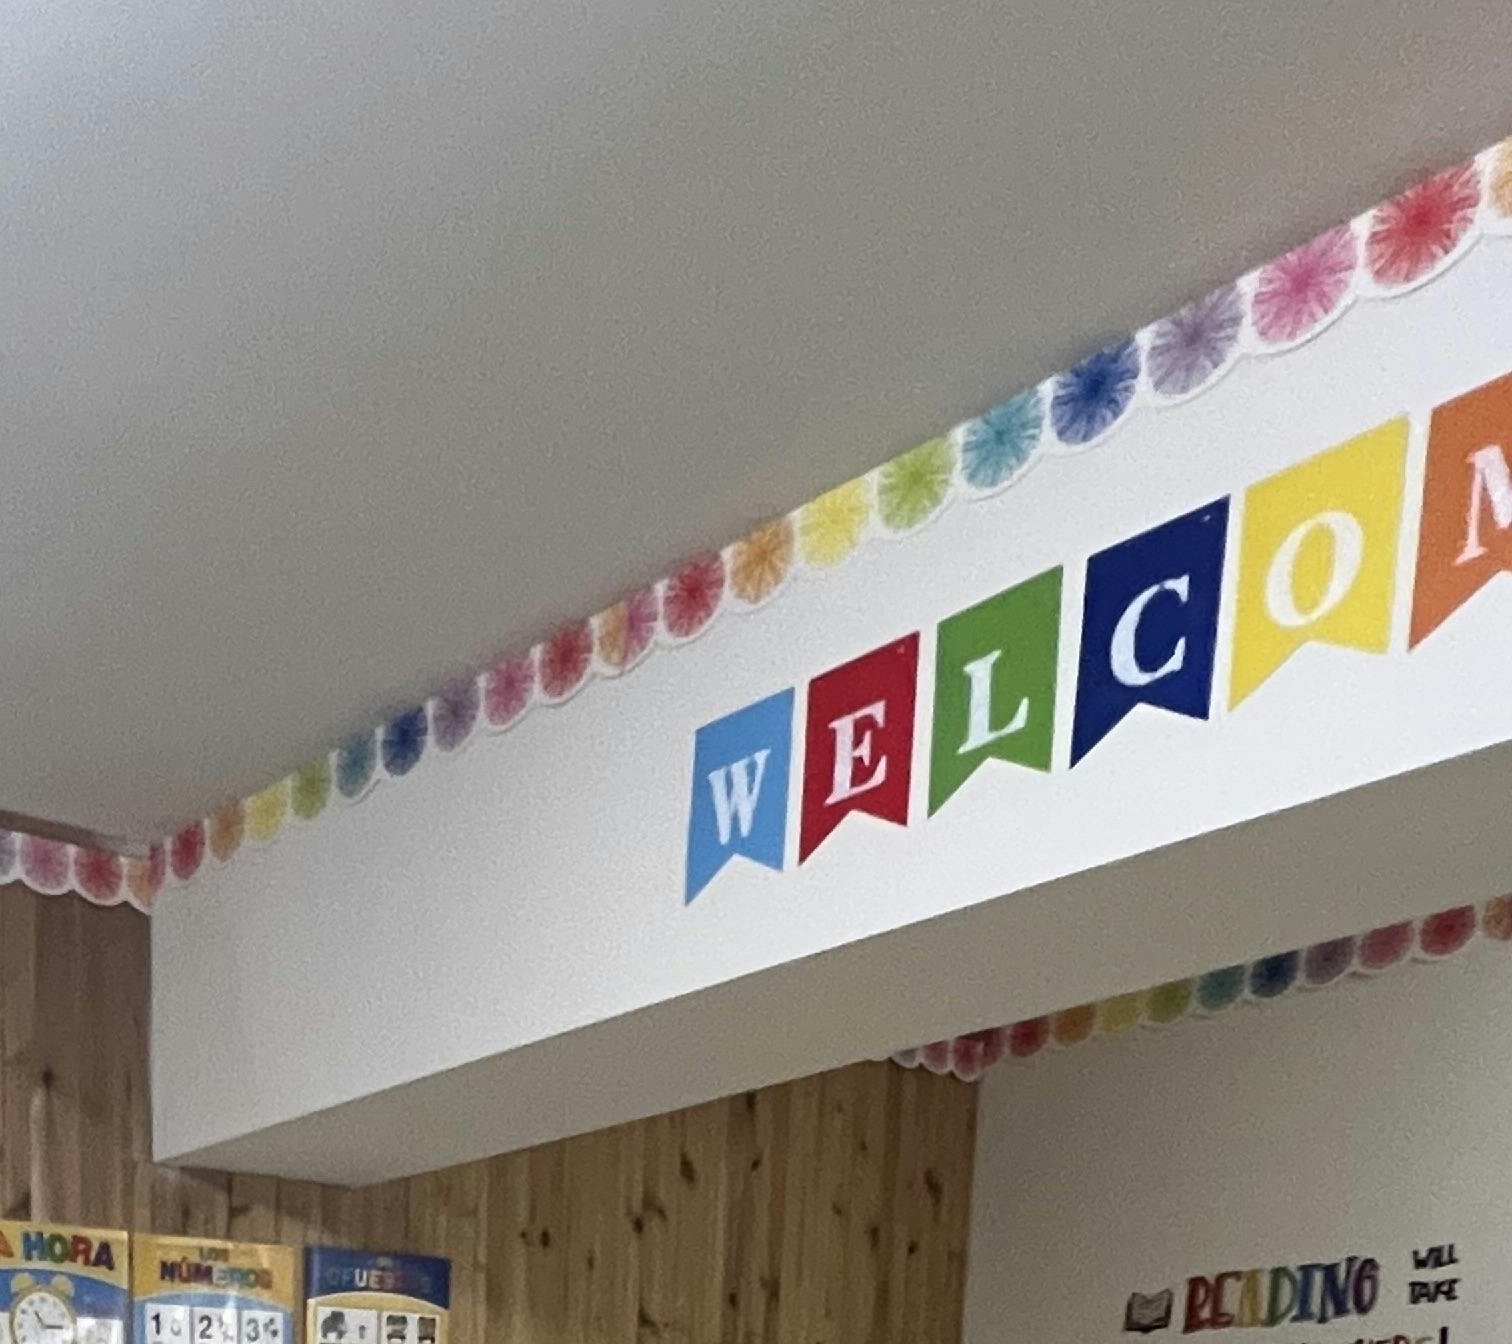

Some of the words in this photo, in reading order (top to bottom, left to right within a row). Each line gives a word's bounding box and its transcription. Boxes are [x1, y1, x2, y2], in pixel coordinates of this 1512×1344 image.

[21, 1231, 115, 1271] HORA
[1412, 1243, 1459, 1270] WILL
[159, 1256, 275, 1290] NÚMEROS
[1182, 1255, 1380, 1333] READING
[1408, 1277, 1462, 1305] TAKE
[152, 1311, 161, 1337] 1
[198, 1314, 213, 1340] 2
[246, 1317, 260, 1342] 3
